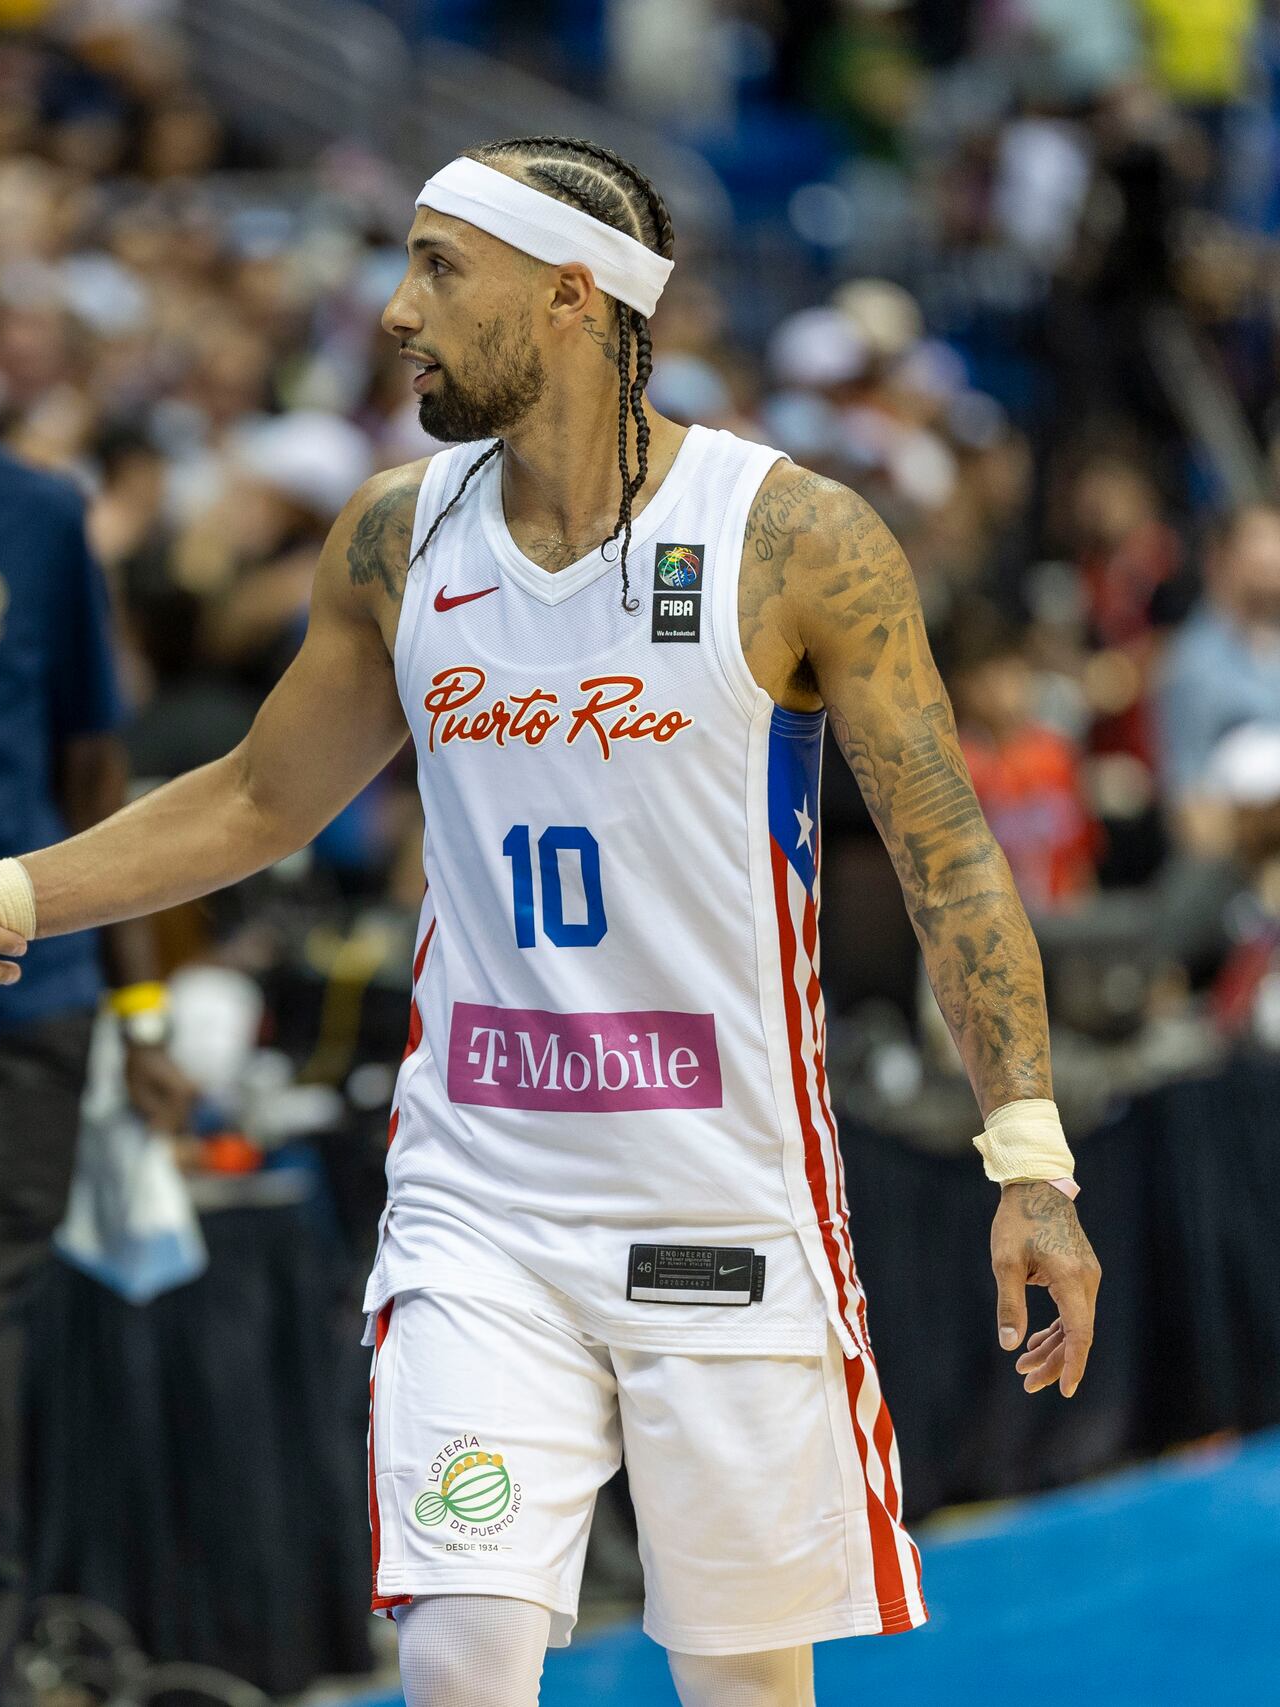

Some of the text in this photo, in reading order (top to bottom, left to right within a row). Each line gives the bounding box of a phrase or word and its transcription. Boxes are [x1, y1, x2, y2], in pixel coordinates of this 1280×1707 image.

[660, 600, 693, 616] FIBA
[423, 666, 693, 761] Puerto Rico
[503, 824, 608, 949] 10
[637, 1261, 652, 1273] 46
[660, 1250, 713, 1259] ENGINEERED
[427, 1434, 480, 1482] LOTERÍA
[450, 1483, 522, 1537] DE PUERTO RICO
[445, 1543, 499, 1552] DESDE 1934
